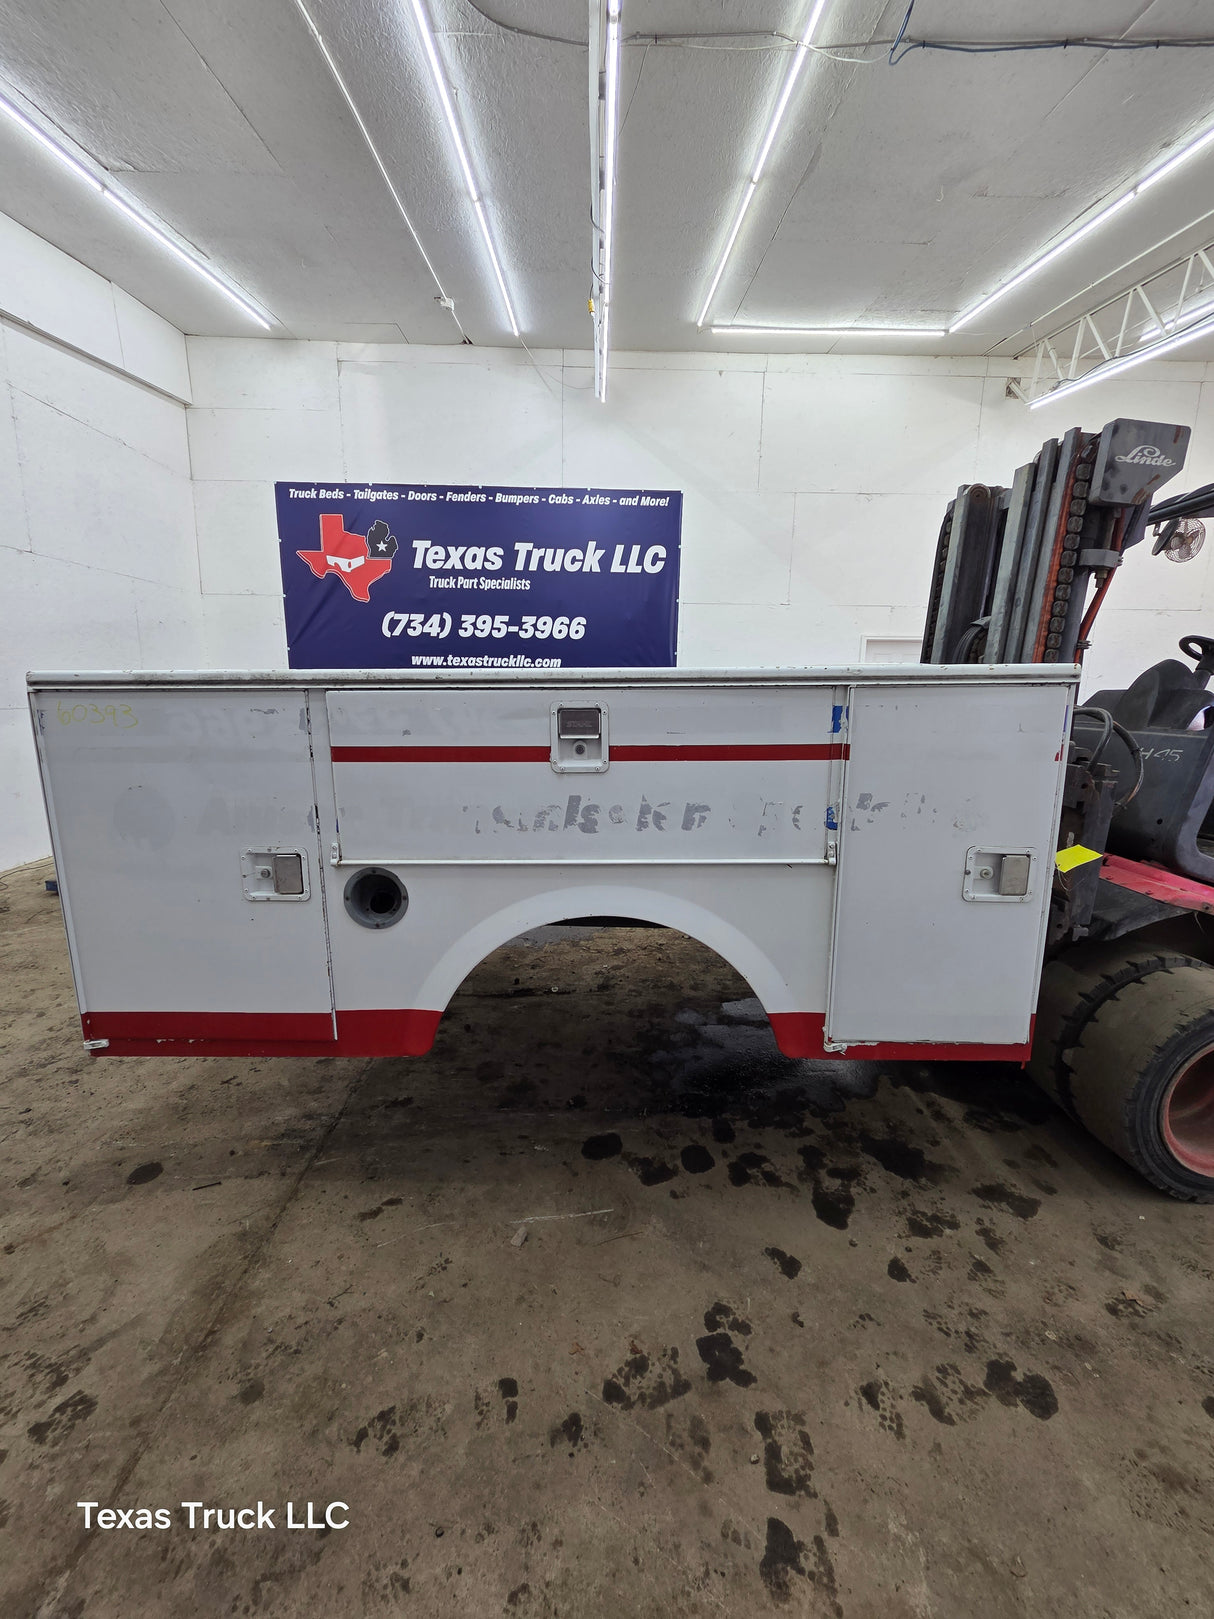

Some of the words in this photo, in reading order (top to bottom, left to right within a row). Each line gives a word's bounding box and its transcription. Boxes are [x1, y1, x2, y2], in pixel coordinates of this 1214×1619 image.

[1115, 445, 1176, 467] Linde
[288, 488, 317, 500] Truck
[318, 489, 344, 500] Beds
[353, 489, 399, 503] Tailgates
[407, 491, 437, 502] Doors
[445, 491, 487, 503] Fenders
[495, 492, 539, 506] Bumpers
[548, 493, 574, 505] Cabs
[582, 494, 611, 505] Axles
[619, 495, 639, 506] and
[640, 496, 670, 507] More!
[412, 540, 504, 571] Texas
[513, 541, 606, 573] Truck
[610, 545, 667, 574] LLC
[429, 576, 456, 590] Truck
[457, 576, 479, 590] Part
[479, 576, 531, 591] Specialists
[381, 611, 452, 639] (734)
[458, 614, 587, 640] 395-3966
[411, 654, 562, 668] www.texastruckllc.com
[57, 700, 138, 729] 60393
